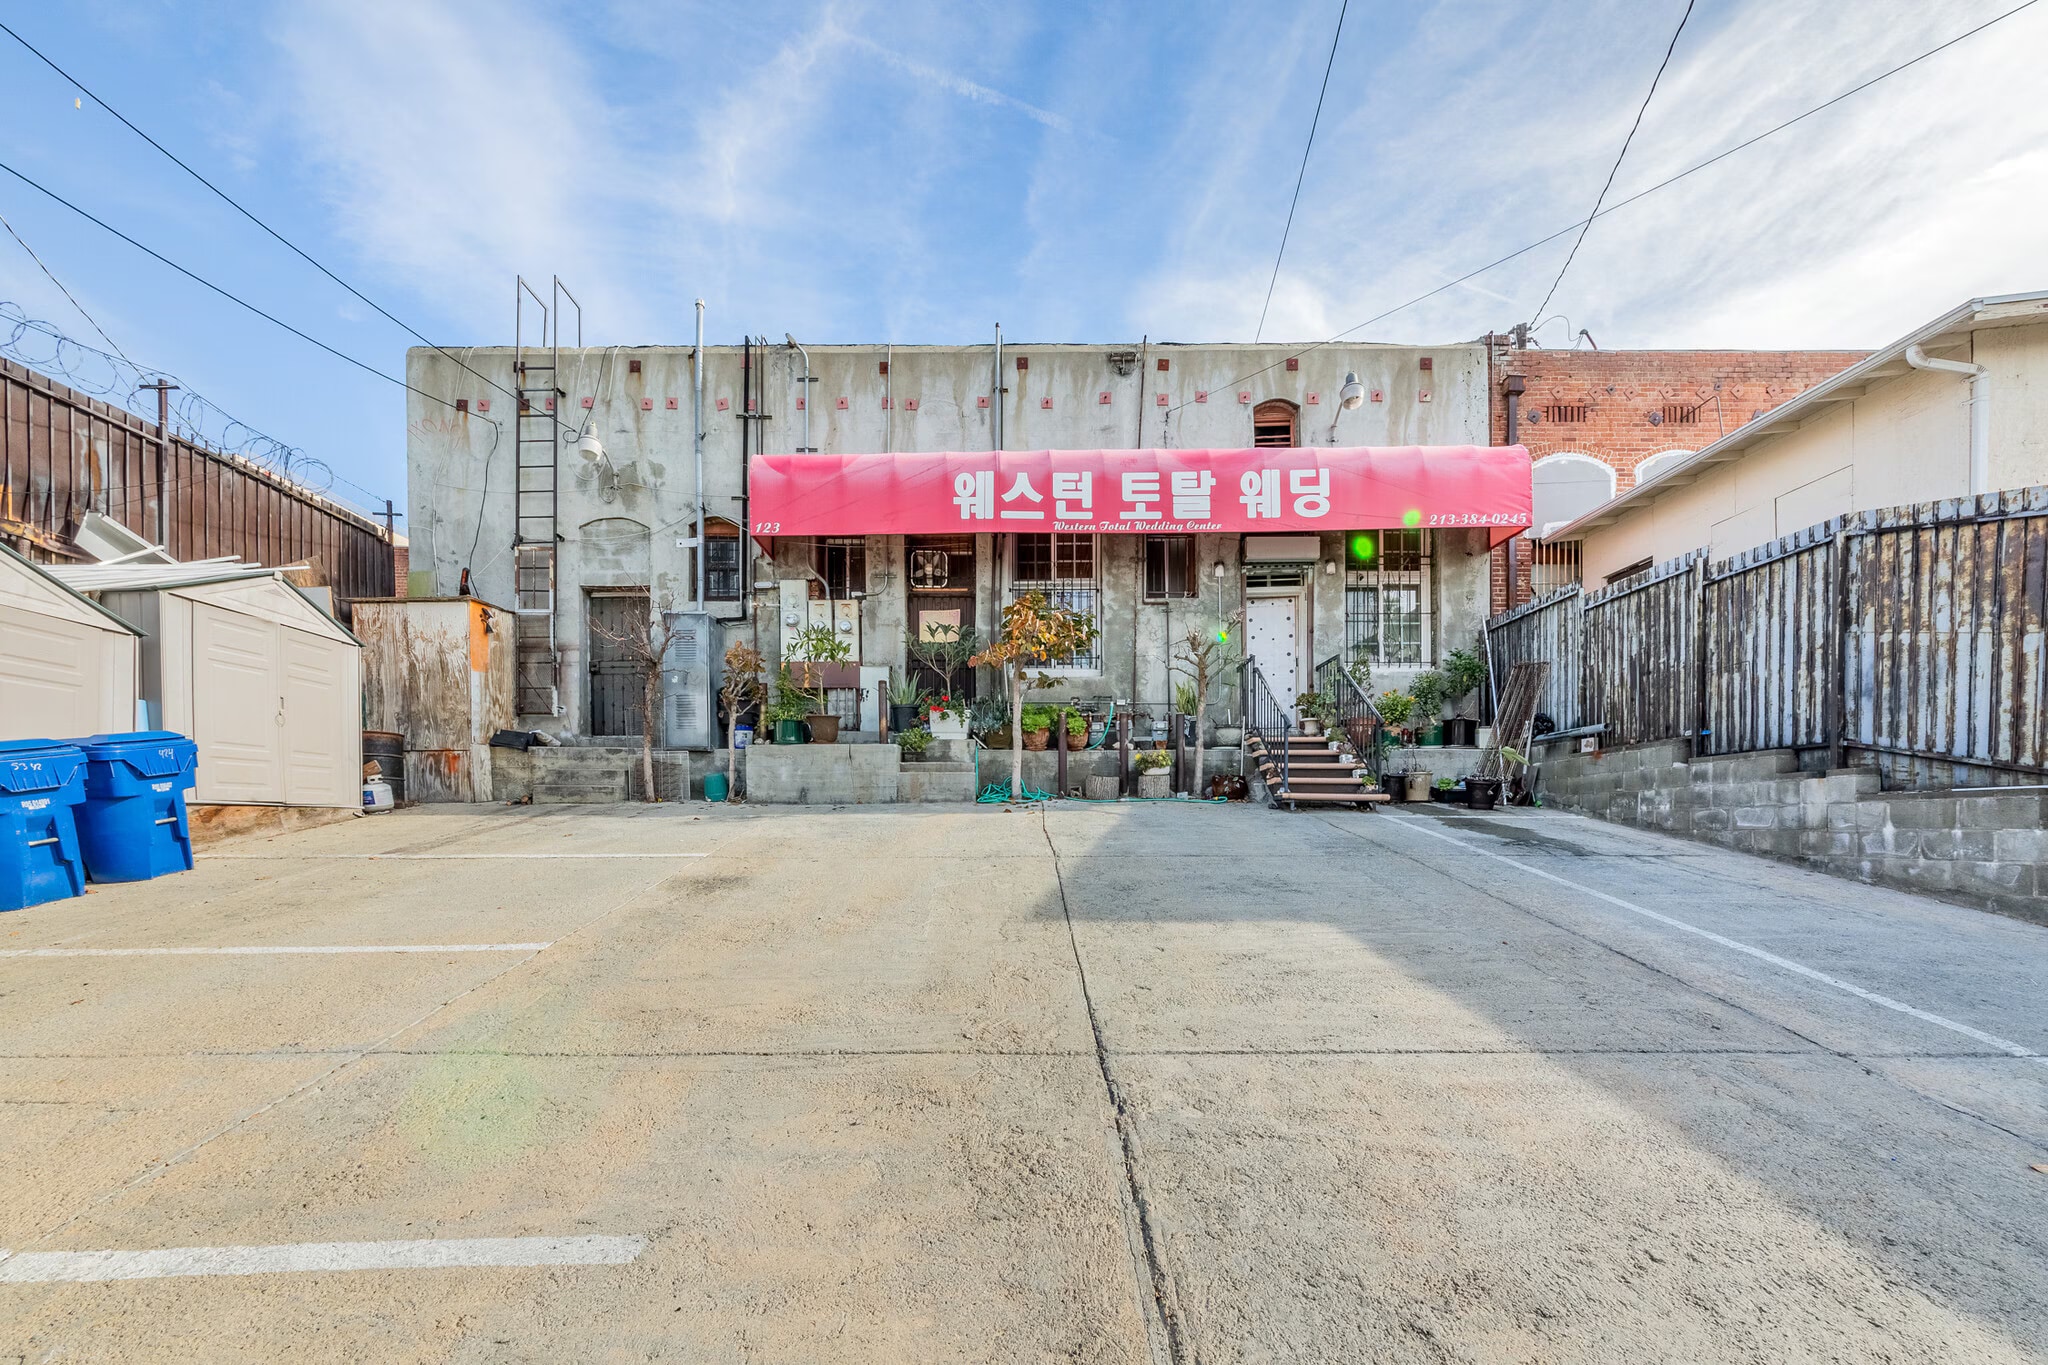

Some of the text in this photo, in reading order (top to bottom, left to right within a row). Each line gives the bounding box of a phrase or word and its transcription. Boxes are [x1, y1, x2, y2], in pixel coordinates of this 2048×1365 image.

[953, 468, 1331, 520] 웨스턴 토탈 웨딩
[1429, 512, 1527, 525] 213-384-0245
[755, 522, 781, 534] 123
[1052, 520, 1223, 532] Western Total Wedding Center
